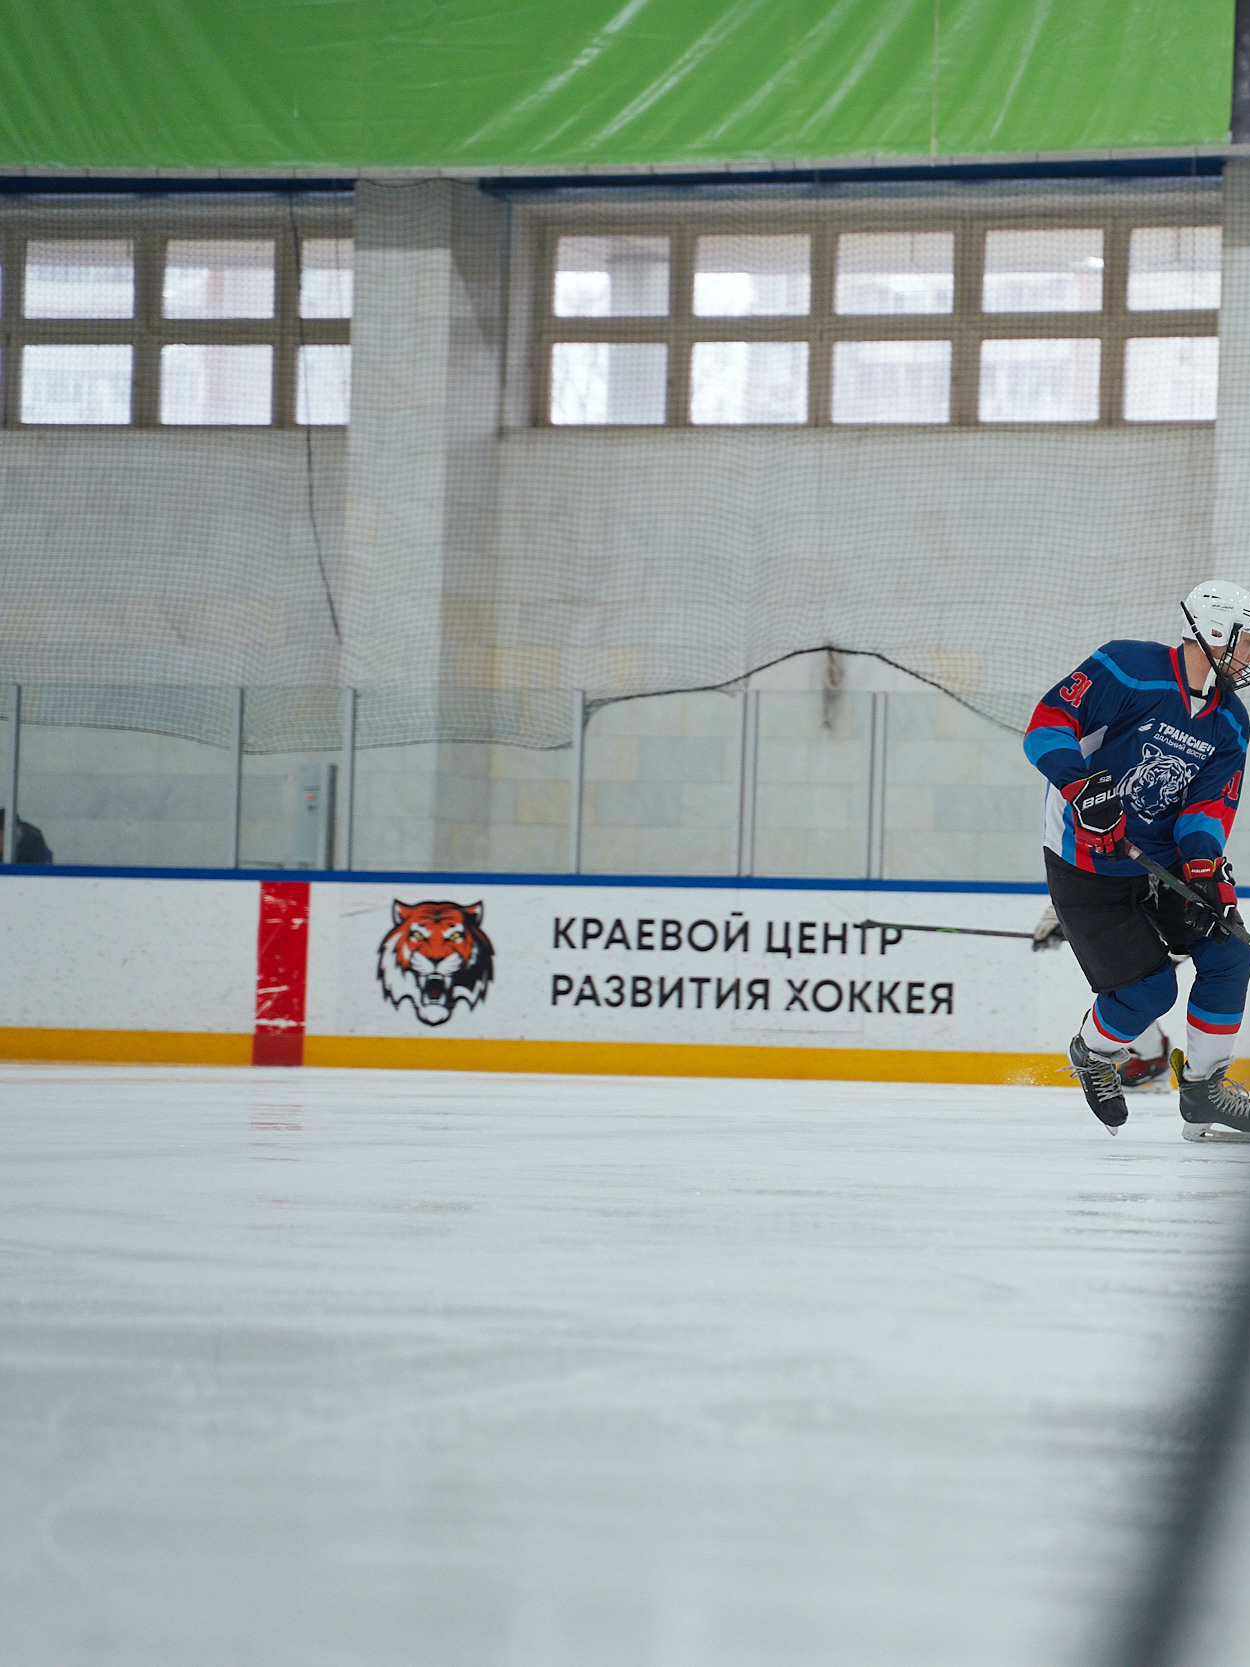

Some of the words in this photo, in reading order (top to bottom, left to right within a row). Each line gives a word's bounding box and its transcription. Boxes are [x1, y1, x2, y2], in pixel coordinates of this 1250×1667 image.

[1059, 671, 1093, 708] 31
[1186, 747, 1207, 761] ВОСТО
[1081, 787, 1117, 811] BAU
[553, 912, 749, 952] КРАЕВОЙ
[765, 920, 902, 958] ЦЕНТР
[551, 974, 770, 1010] РАЗВИТИЯ
[785, 979, 953, 1015] ХОККЕЯ
